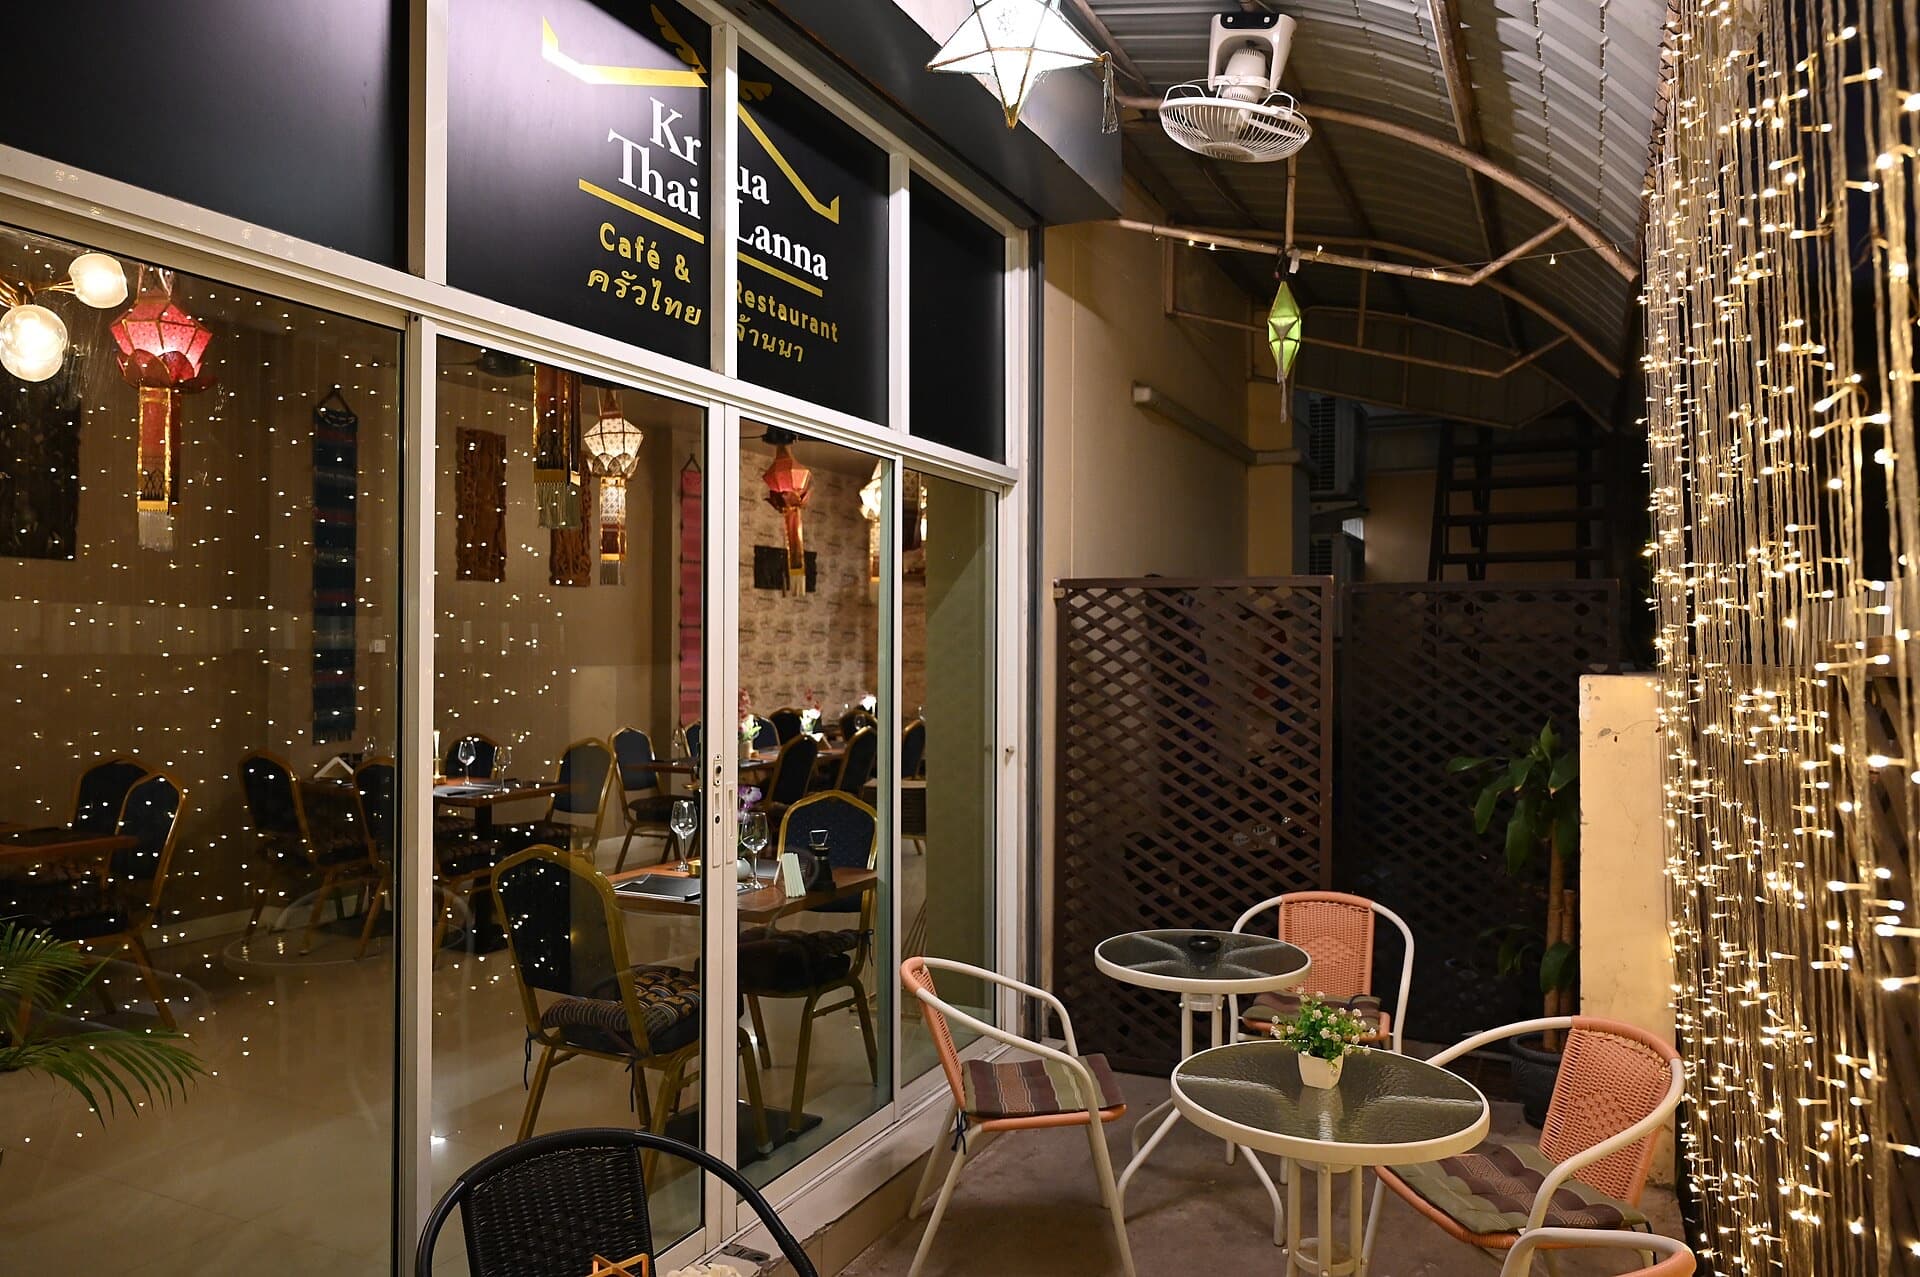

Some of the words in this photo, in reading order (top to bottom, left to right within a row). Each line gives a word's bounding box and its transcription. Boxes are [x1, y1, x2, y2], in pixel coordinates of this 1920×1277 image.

[608, 128, 701, 219] Thai
[599, 222, 660, 270] Café
[675, 253, 691, 283] &
